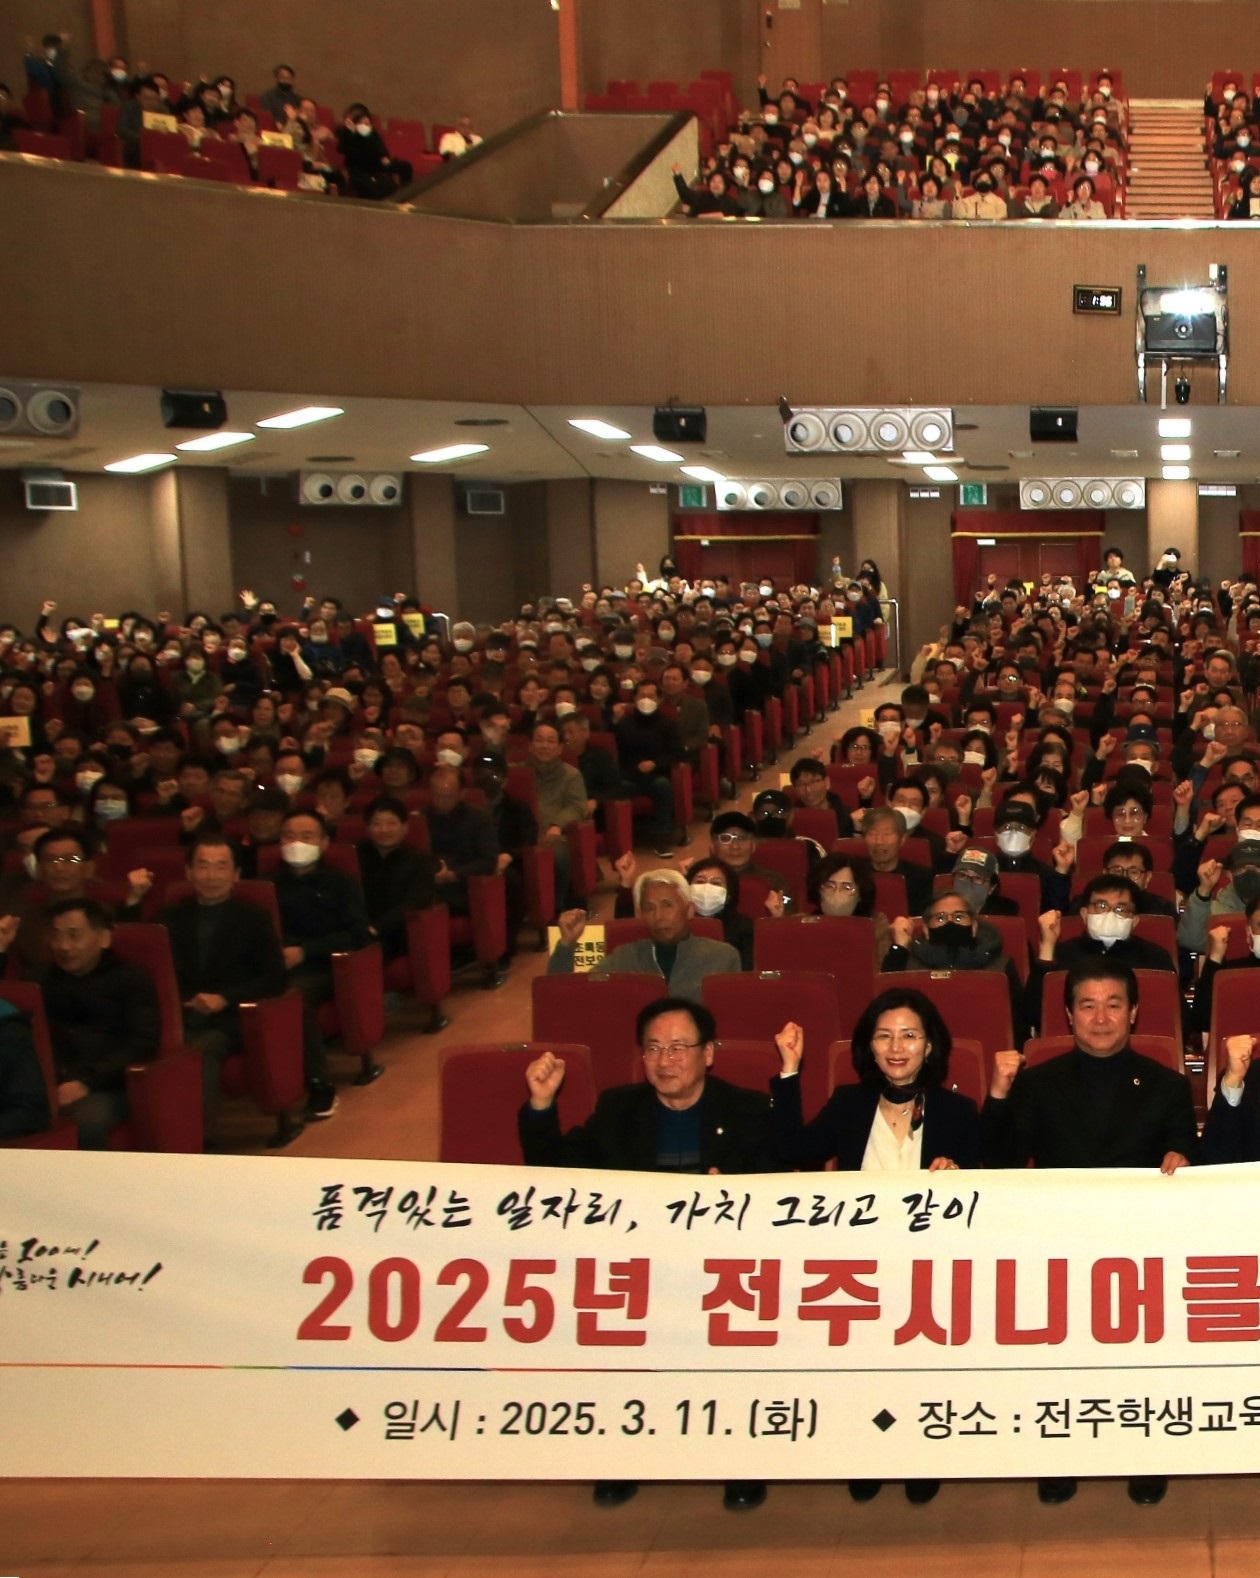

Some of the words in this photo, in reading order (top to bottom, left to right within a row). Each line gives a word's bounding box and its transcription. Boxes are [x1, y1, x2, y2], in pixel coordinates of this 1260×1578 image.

[312, 1183, 472, 1233] 품격있는
[496, 1185, 638, 1233] 일자리,
[665, 1189, 751, 1231] 가치
[771, 1193, 879, 1227] 그리고
[901, 1188, 980, 1233] 같이
[298, 1256, 651, 1346] 2025년
[383, 1399, 461, 1441] 일시
[499, 1401, 606, 1436] 2025.
[621, 1399, 656, 1436] 3.
[676, 1399, 732, 1436] 11.
[749, 1397, 818, 1442] (화)
[917, 1399, 998, 1440] 장소
